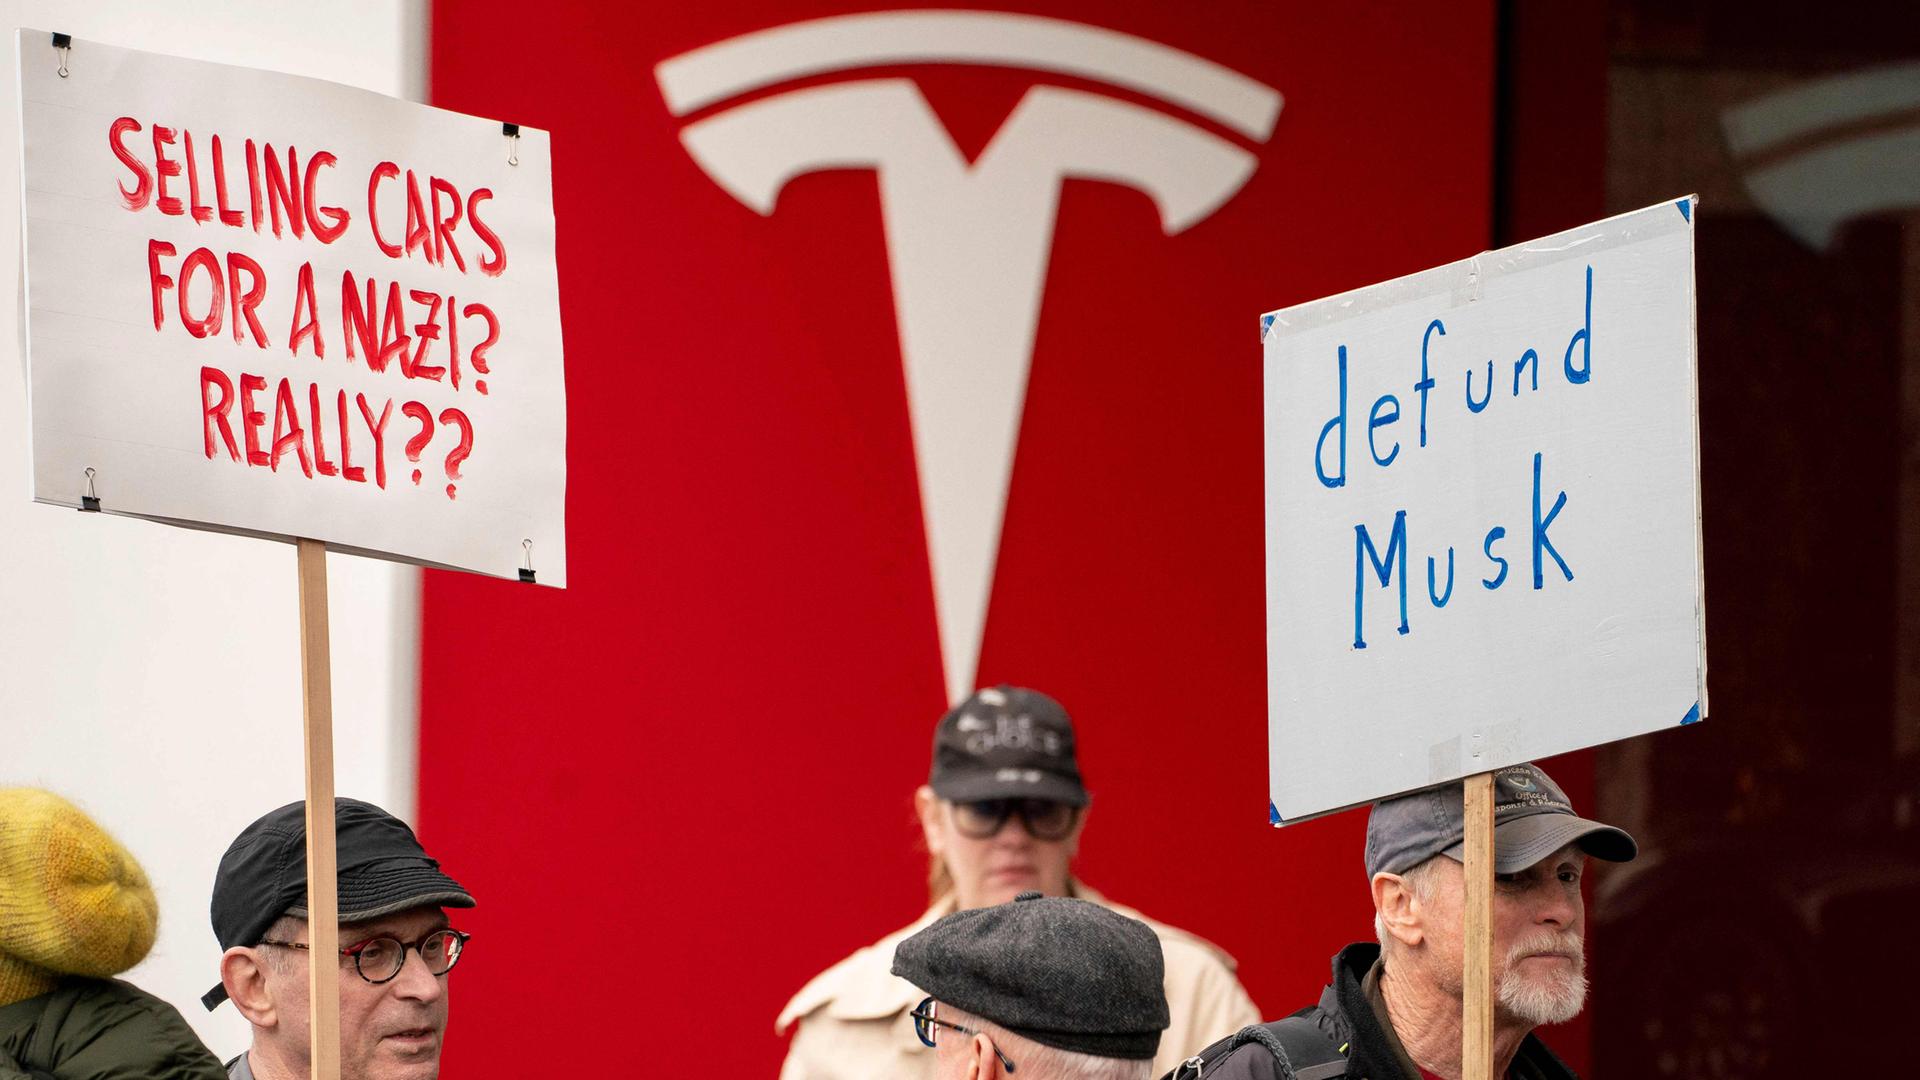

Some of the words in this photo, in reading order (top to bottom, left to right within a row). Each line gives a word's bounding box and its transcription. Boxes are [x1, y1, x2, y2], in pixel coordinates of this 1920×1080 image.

[108, 116, 351, 245] SELLING
[367, 160, 508, 277] CARS
[147, 238, 270, 350] FOR
[287, 260, 326, 360] A
[340, 269, 501, 396] NAZI?
[1314, 265, 1594, 489] defund
[199, 365, 475, 500] REALLY??
[1353, 451, 1575, 650] Musk
[1495, 801, 1527, 812] sponse
[1515, 791, 1541, 801] Office
